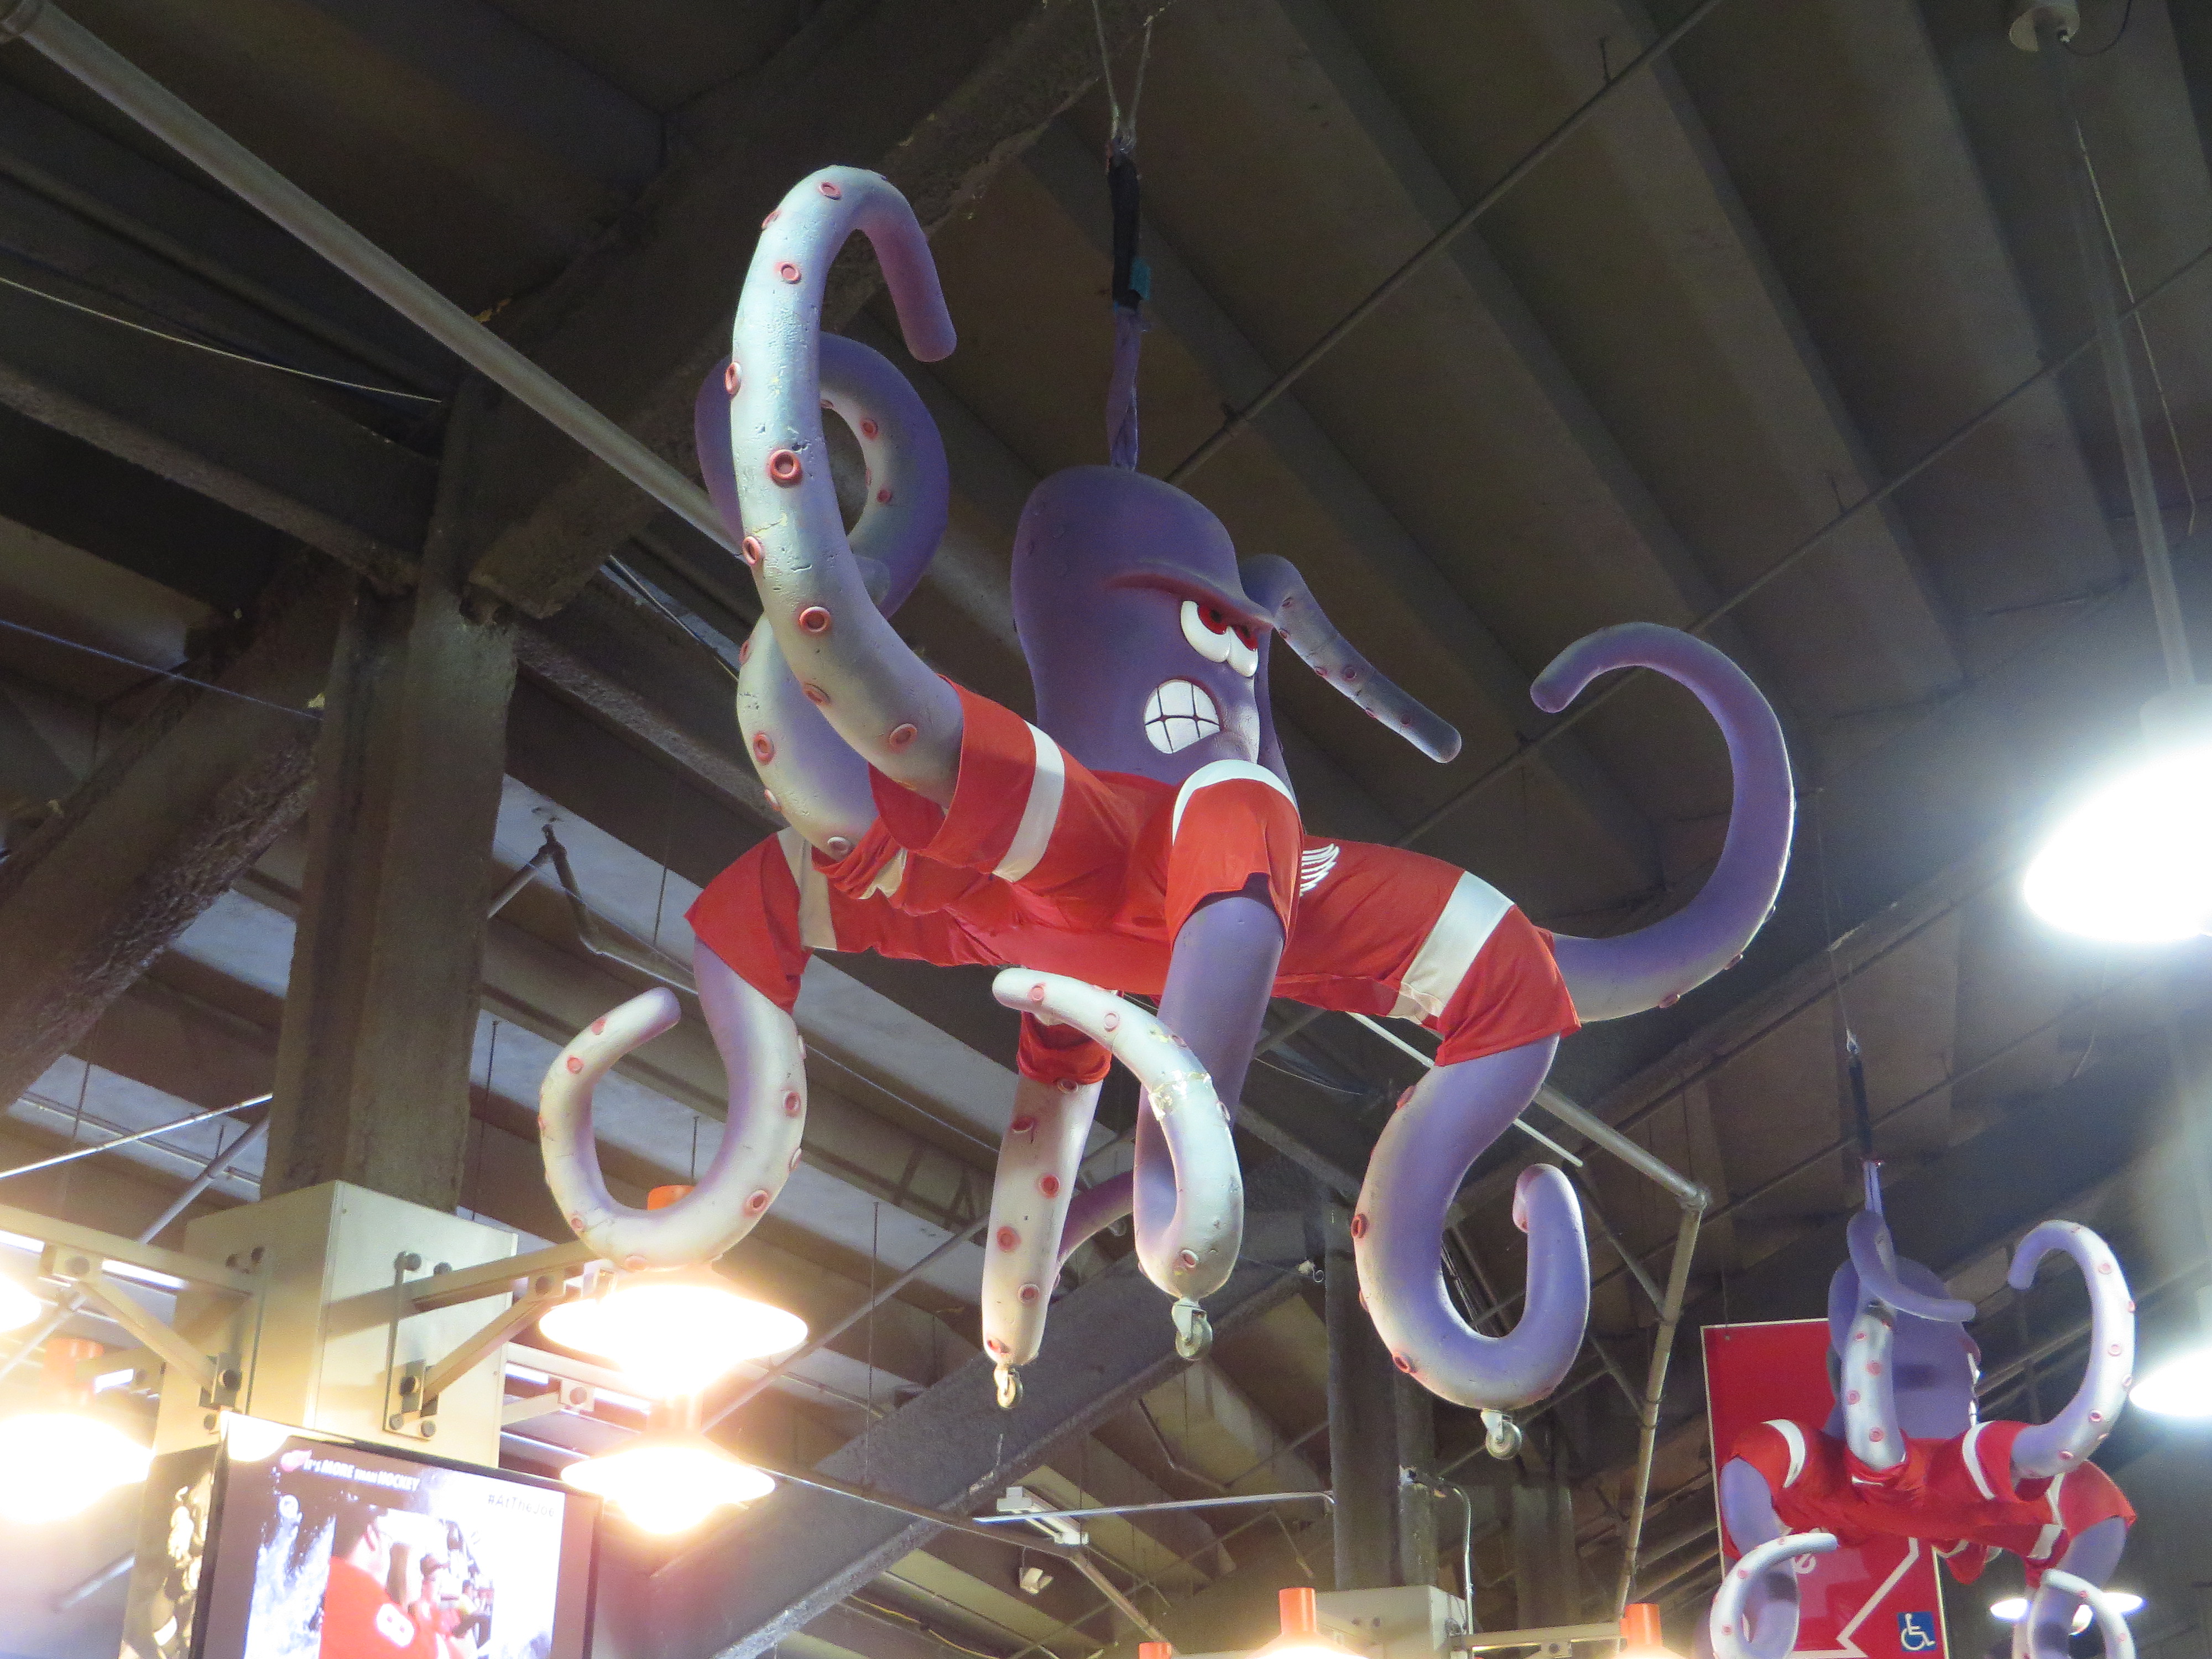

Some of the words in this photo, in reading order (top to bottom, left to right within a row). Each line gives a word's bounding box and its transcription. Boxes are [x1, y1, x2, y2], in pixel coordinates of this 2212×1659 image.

[321, 1459, 355, 1479] MORE
[377, 1470, 421, 1491] HOCKEY
[487, 1494, 555, 1517] #AtTheJoe
